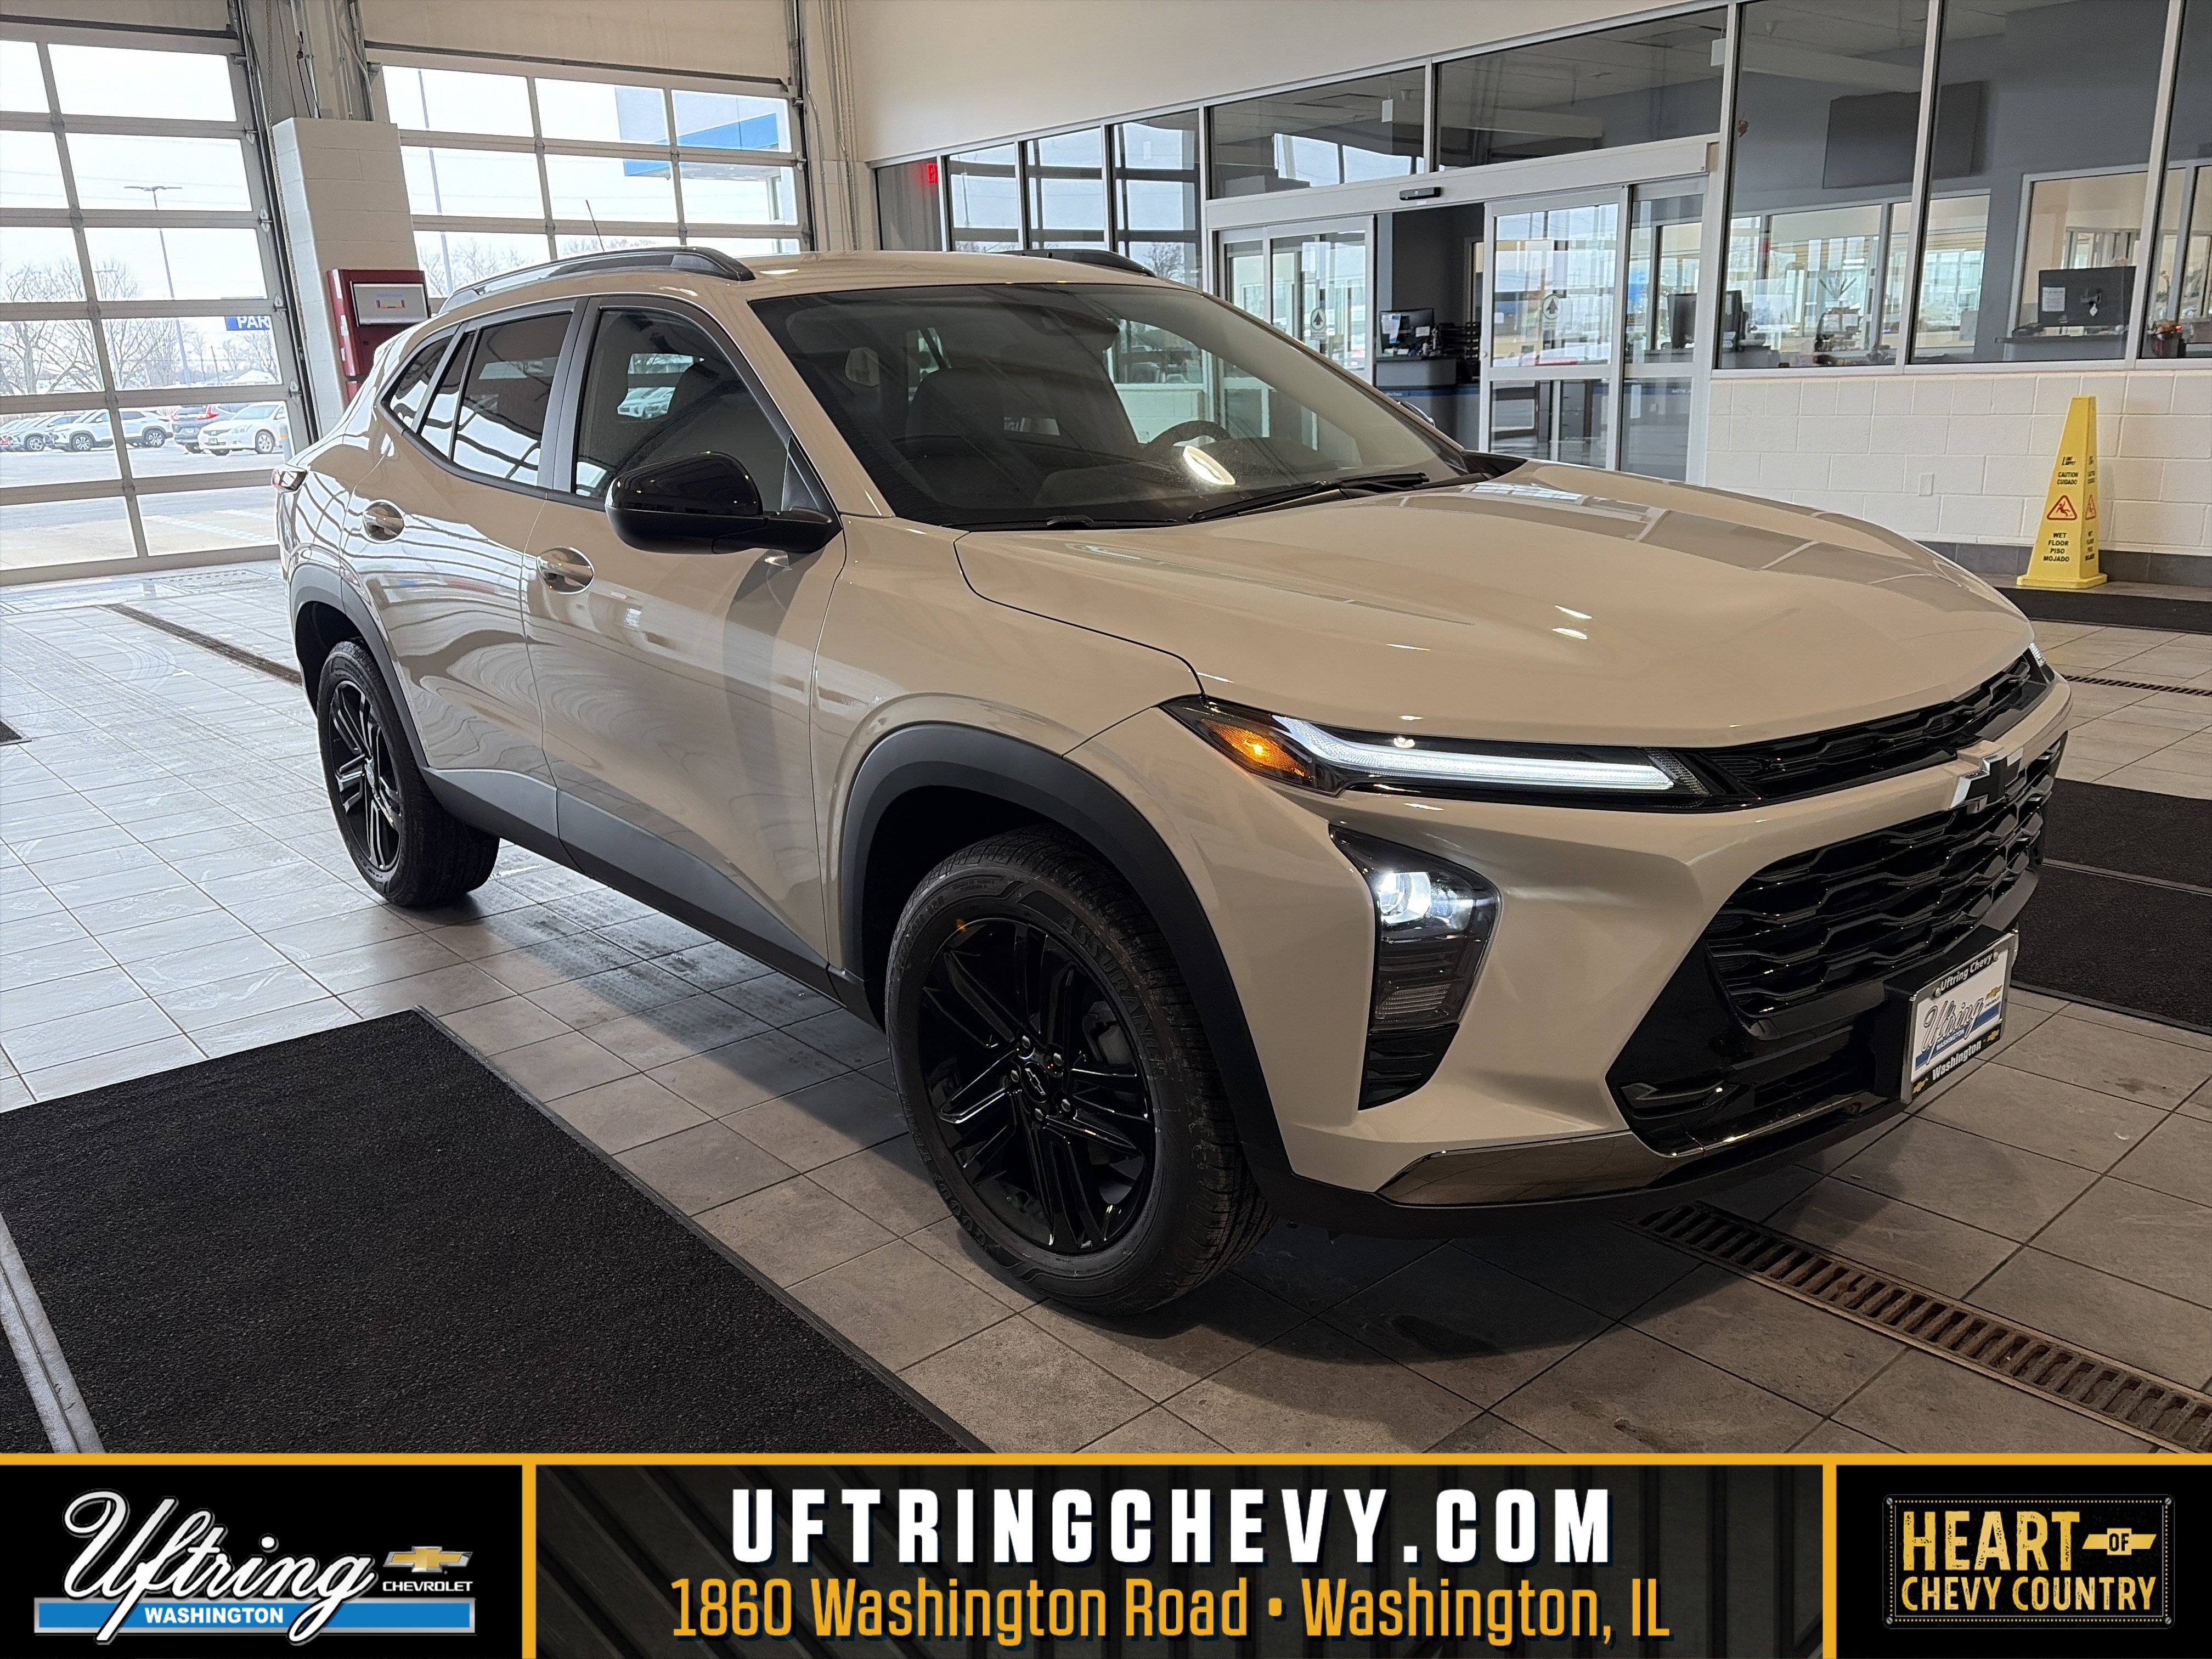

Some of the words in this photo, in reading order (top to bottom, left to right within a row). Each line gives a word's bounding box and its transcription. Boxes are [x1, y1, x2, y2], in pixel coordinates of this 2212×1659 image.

[1940, 968, 1969, 991] Uftring
[1970, 953, 1993, 973] Chevy
[1922, 997, 1984, 1065] Uftring
[1936, 1028, 1965, 1051] WASHINGTON
[1932, 1040, 1982, 1081] Washington
